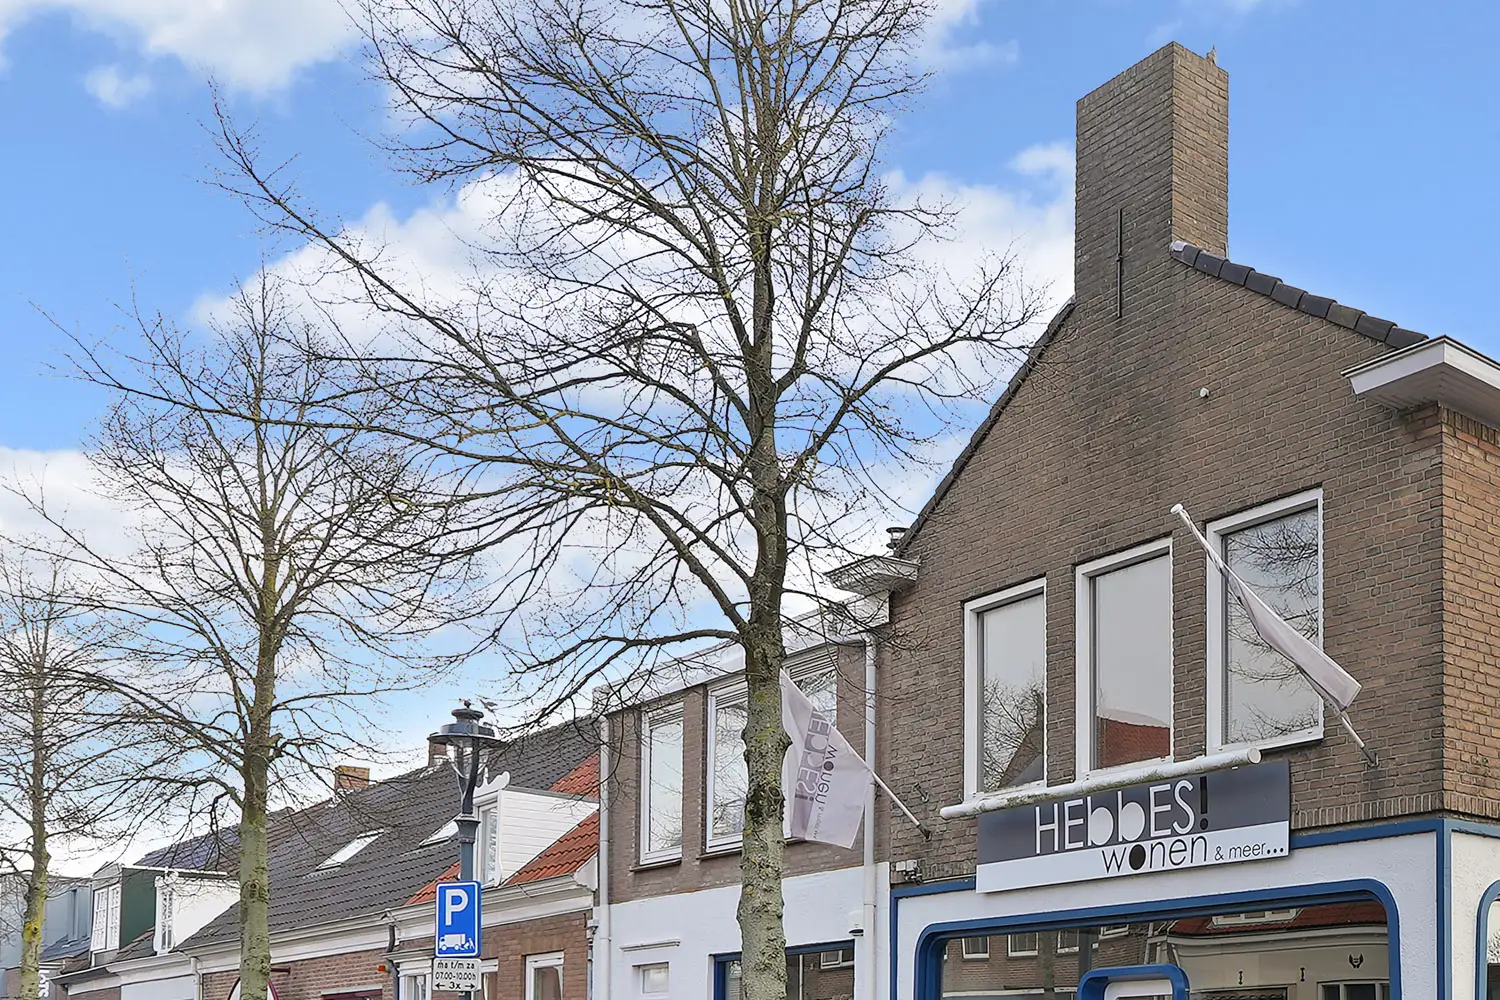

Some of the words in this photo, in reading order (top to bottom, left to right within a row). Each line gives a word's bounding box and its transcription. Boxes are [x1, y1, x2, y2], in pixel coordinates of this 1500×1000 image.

[1102, 834, 1208, 874] wonen
[1214, 845, 1224, 861] &
[1229, 842, 1284, 860] meer...
[445, 888, 469, 926] P
[450, 960, 464, 969] t/m
[449, 981, 461, 989] 3x
